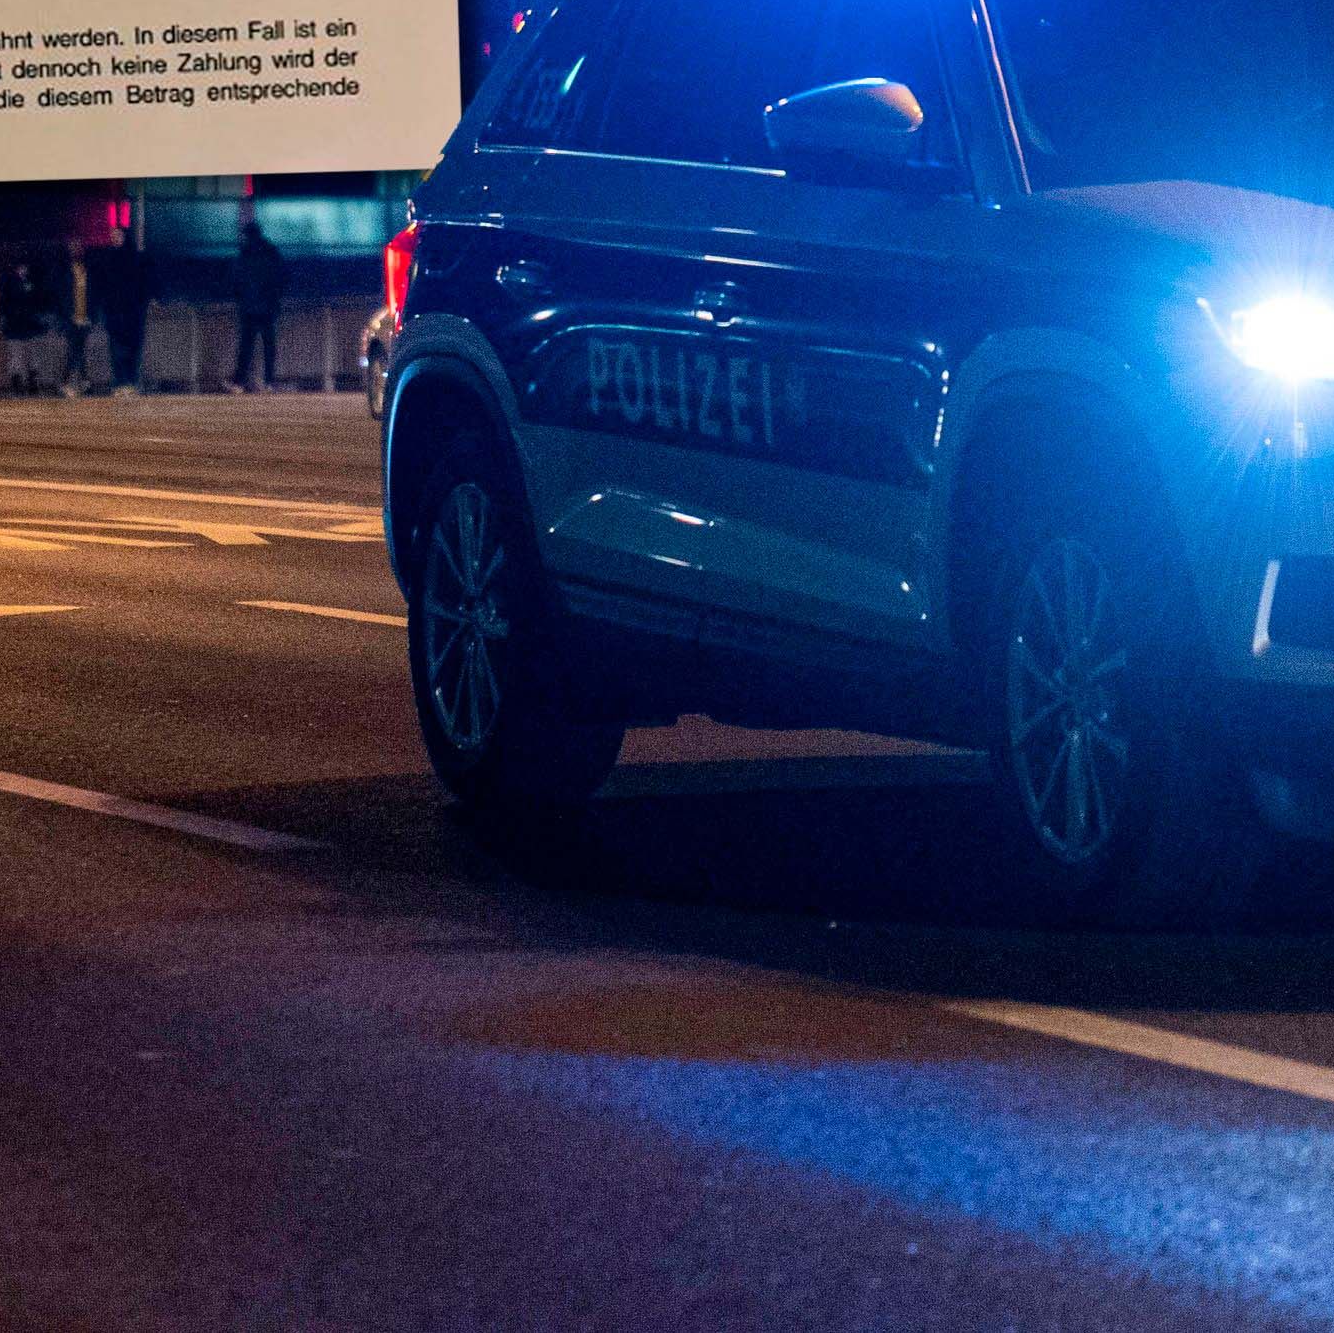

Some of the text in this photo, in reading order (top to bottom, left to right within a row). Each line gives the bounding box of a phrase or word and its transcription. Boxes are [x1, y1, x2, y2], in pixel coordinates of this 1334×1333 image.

[41, 28, 124, 49] werden.
[134, 26, 154, 45] In
[162, 24, 238, 44] diesem
[248, 20, 284, 41] Fall
[294, 19, 316, 38] ist
[325, 17, 356, 37] ein
[587, 337, 774, 445] POLIZEI
